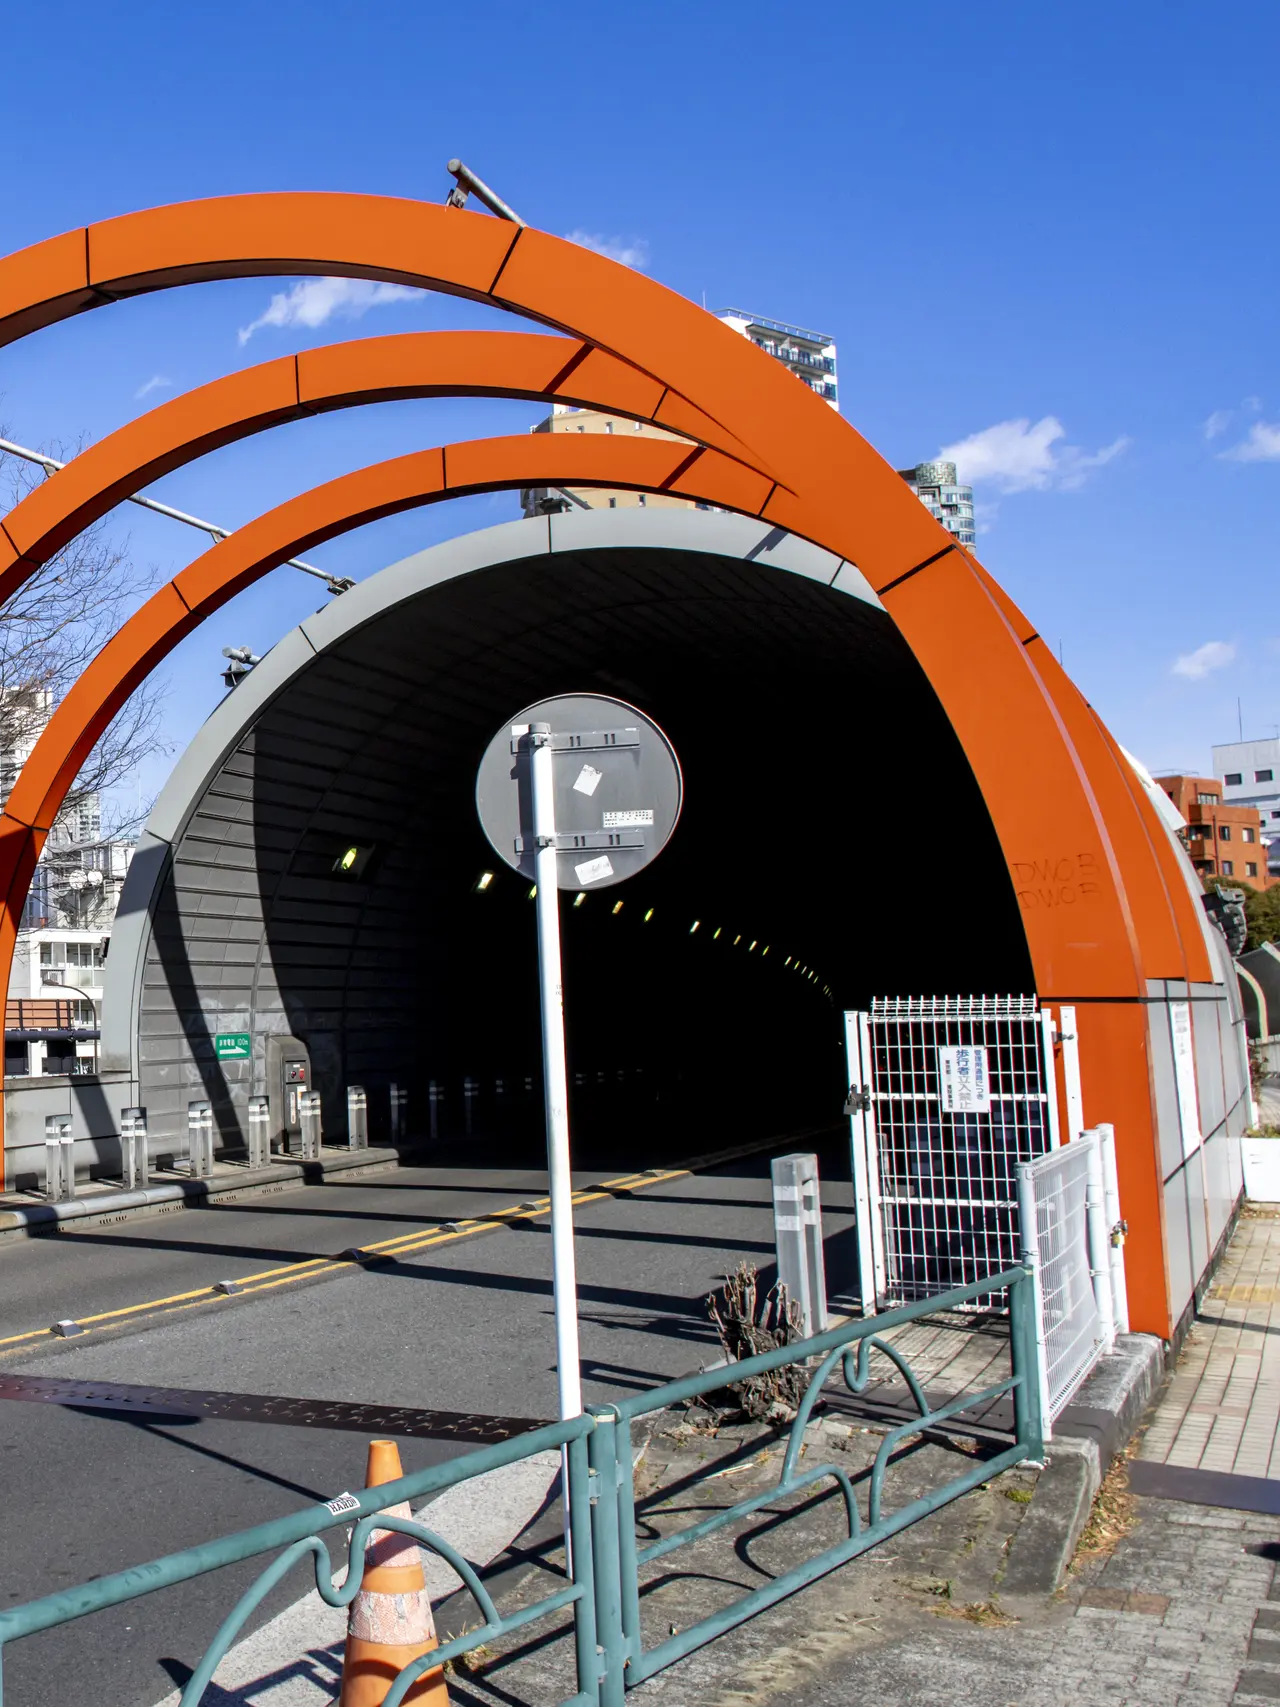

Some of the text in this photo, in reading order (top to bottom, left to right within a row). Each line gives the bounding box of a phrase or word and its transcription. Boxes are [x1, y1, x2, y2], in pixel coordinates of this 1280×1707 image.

[956, 1049, 972, 1109] 歩行者立入禁止
